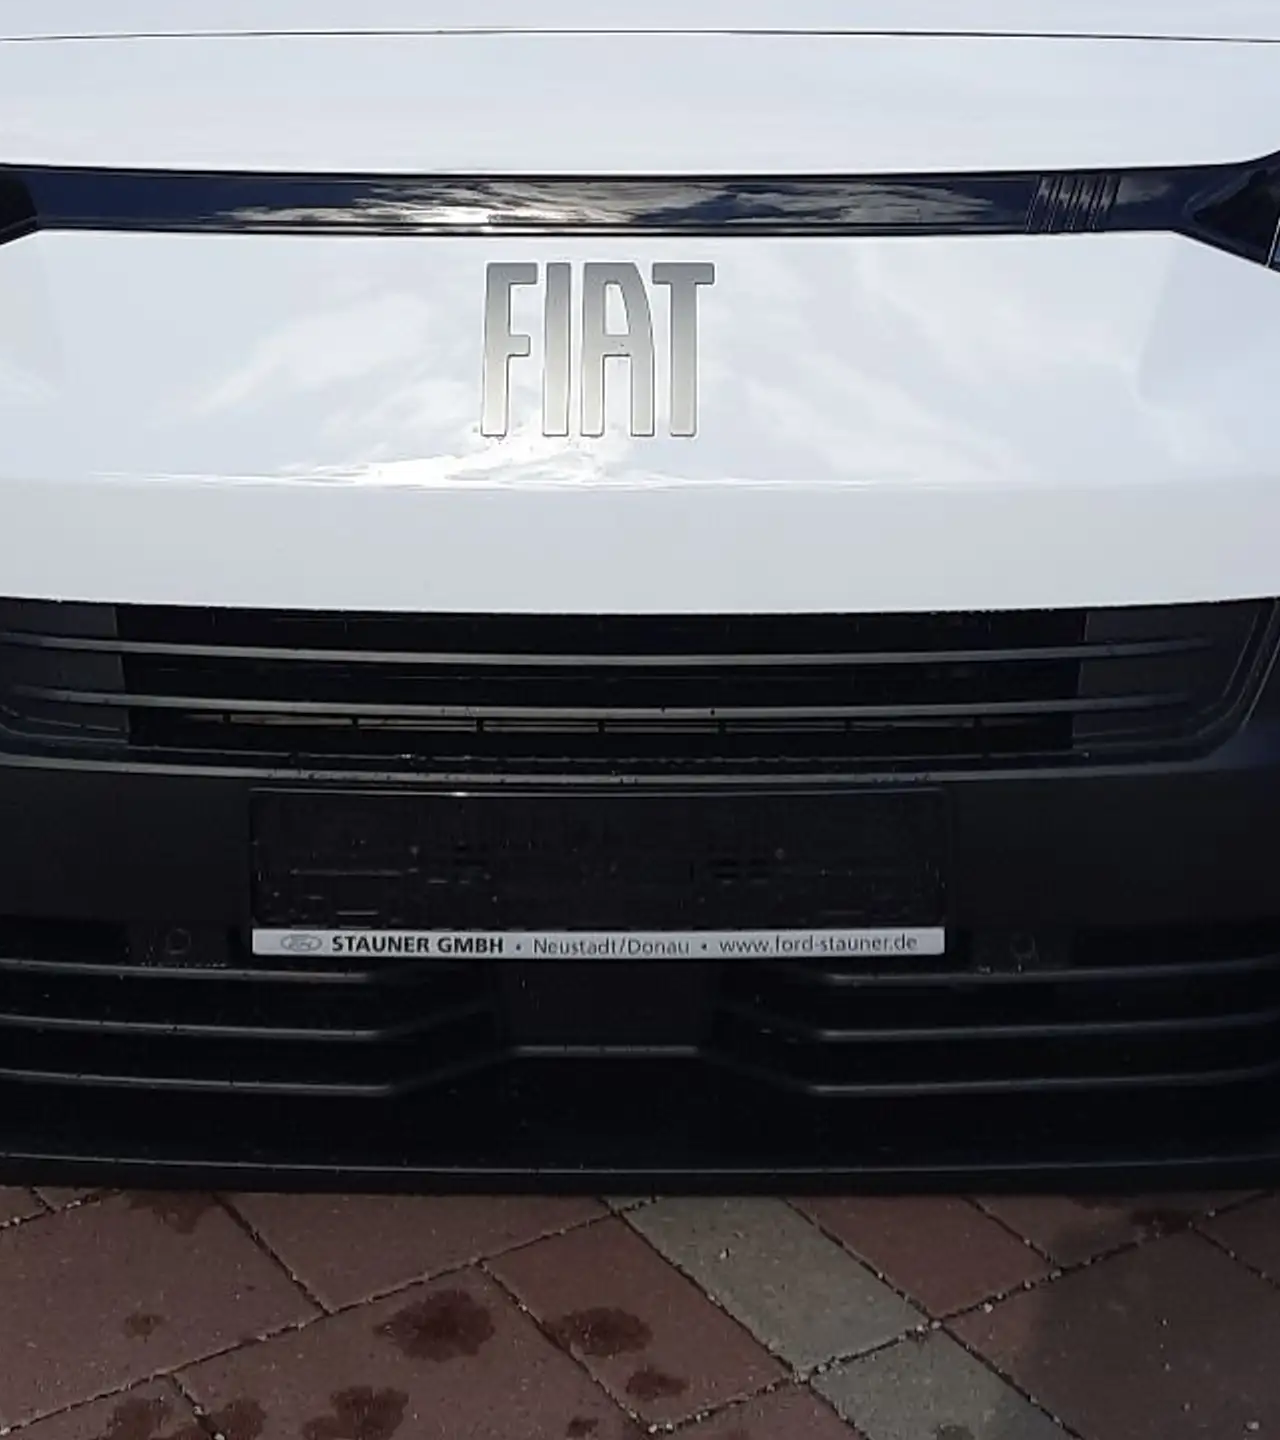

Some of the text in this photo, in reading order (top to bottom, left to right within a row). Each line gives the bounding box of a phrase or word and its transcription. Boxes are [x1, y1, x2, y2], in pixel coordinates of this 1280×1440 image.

[480, 262, 716, 438] FIAT
[331, 935, 430, 953] STAUNER
[437, 936, 505, 954] GMBH
[532, 936, 690, 955] Neustadt/Donau
[719, 933, 918, 955] www.ford-stauner.de
